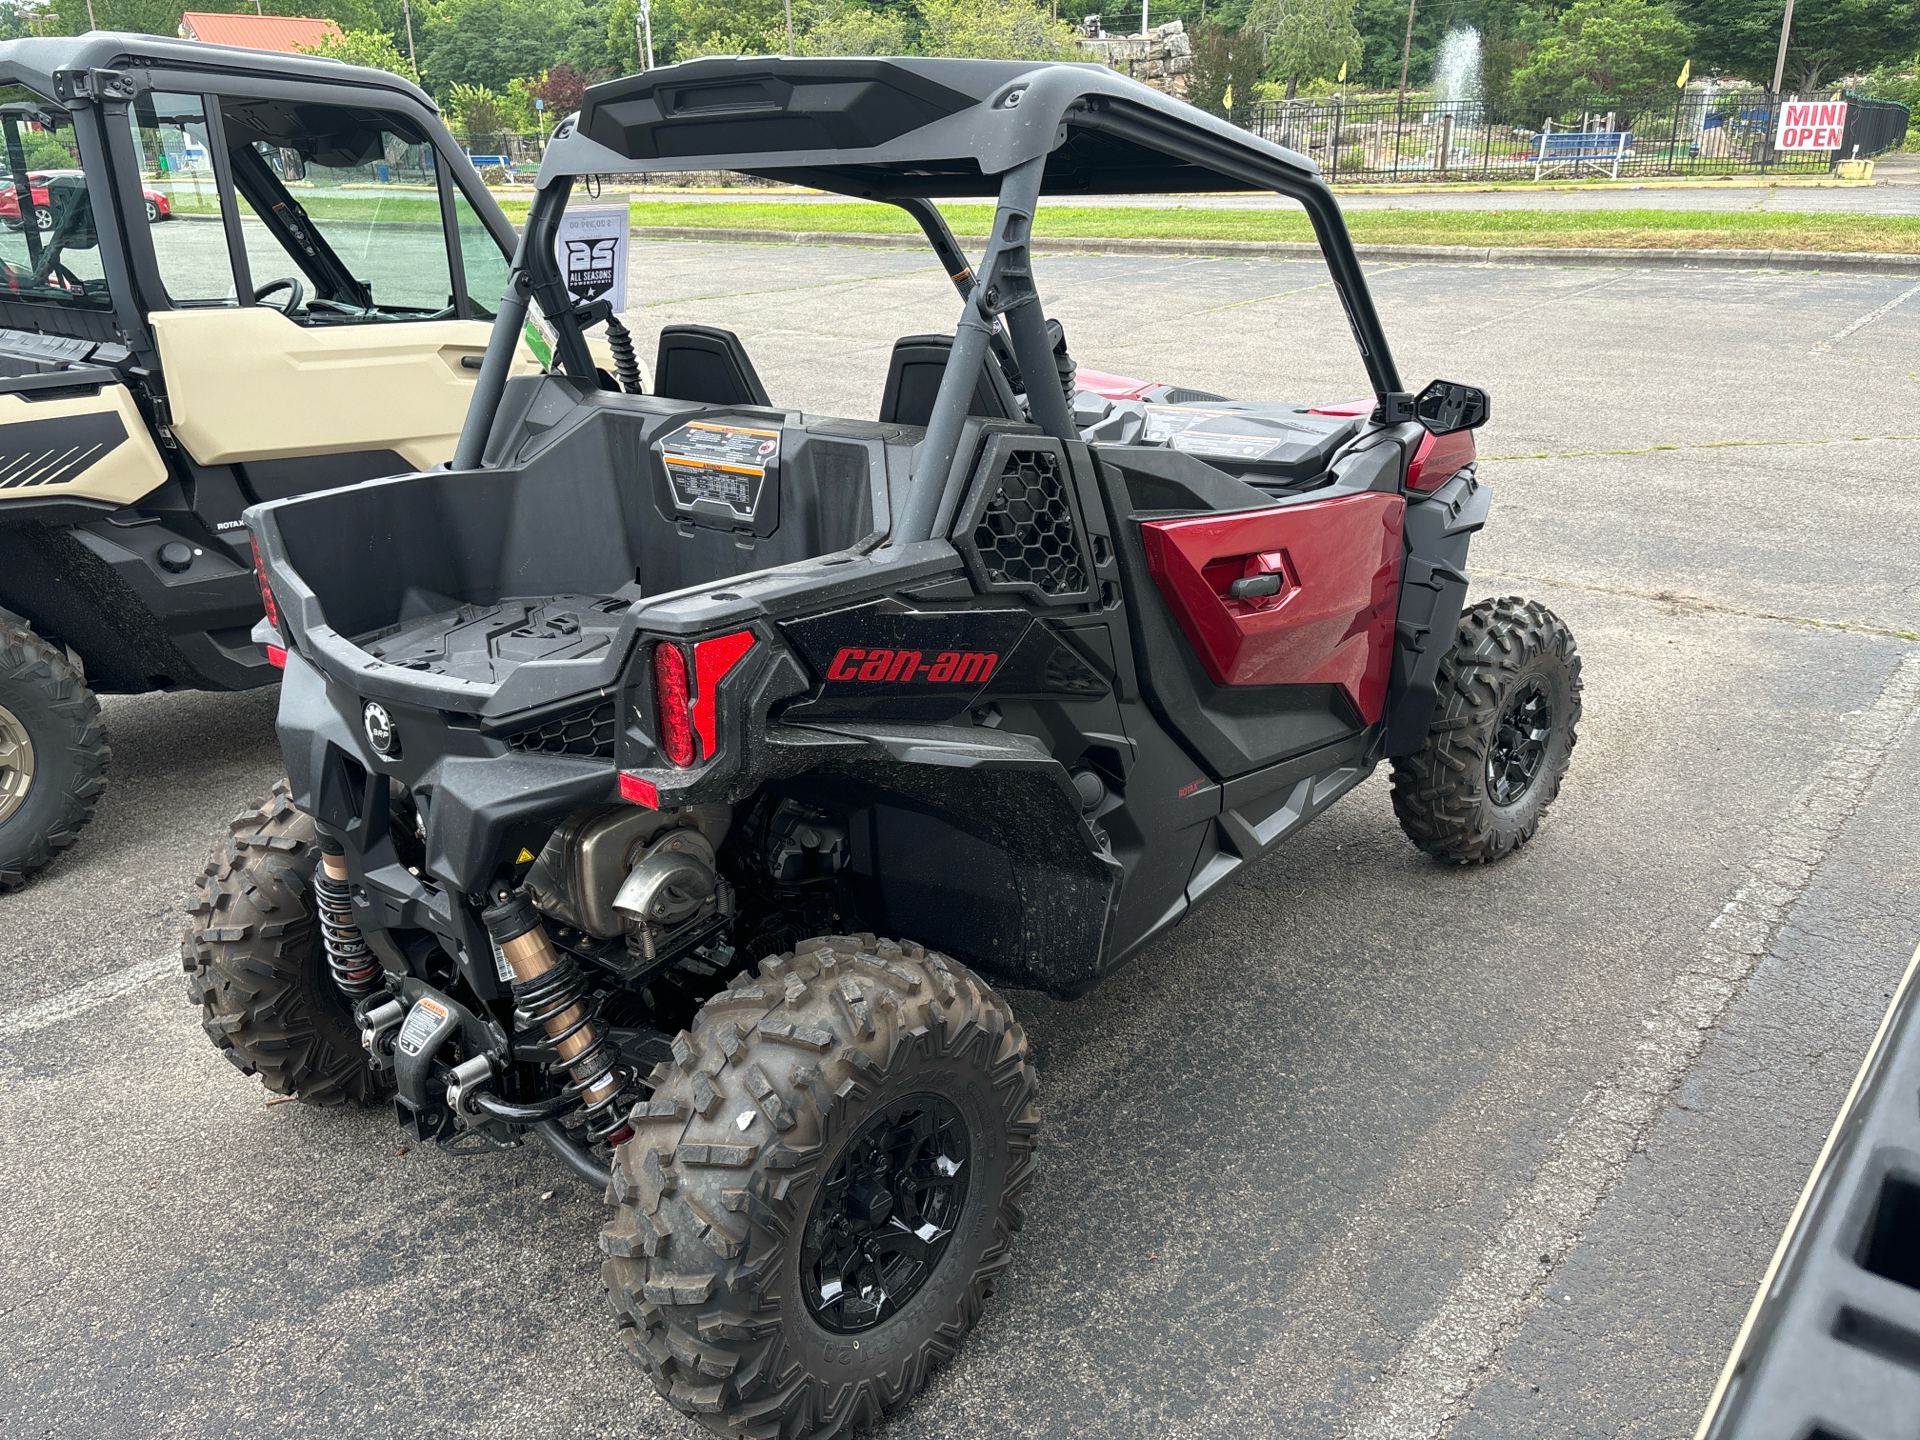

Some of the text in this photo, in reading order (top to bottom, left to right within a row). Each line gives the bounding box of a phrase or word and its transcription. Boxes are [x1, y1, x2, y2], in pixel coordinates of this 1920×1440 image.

[1785, 105, 1846, 126] MINI
[1782, 128, 1842, 147] OPEN
[570, 270, 612, 282] ALL SEASONS
[570, 279, 612, 287] POWERSPORTS
[217, 520, 245, 531] ROTAX
[373, 728, 389, 738] BRP
[1178, 782, 1198, 798] ROTAX
